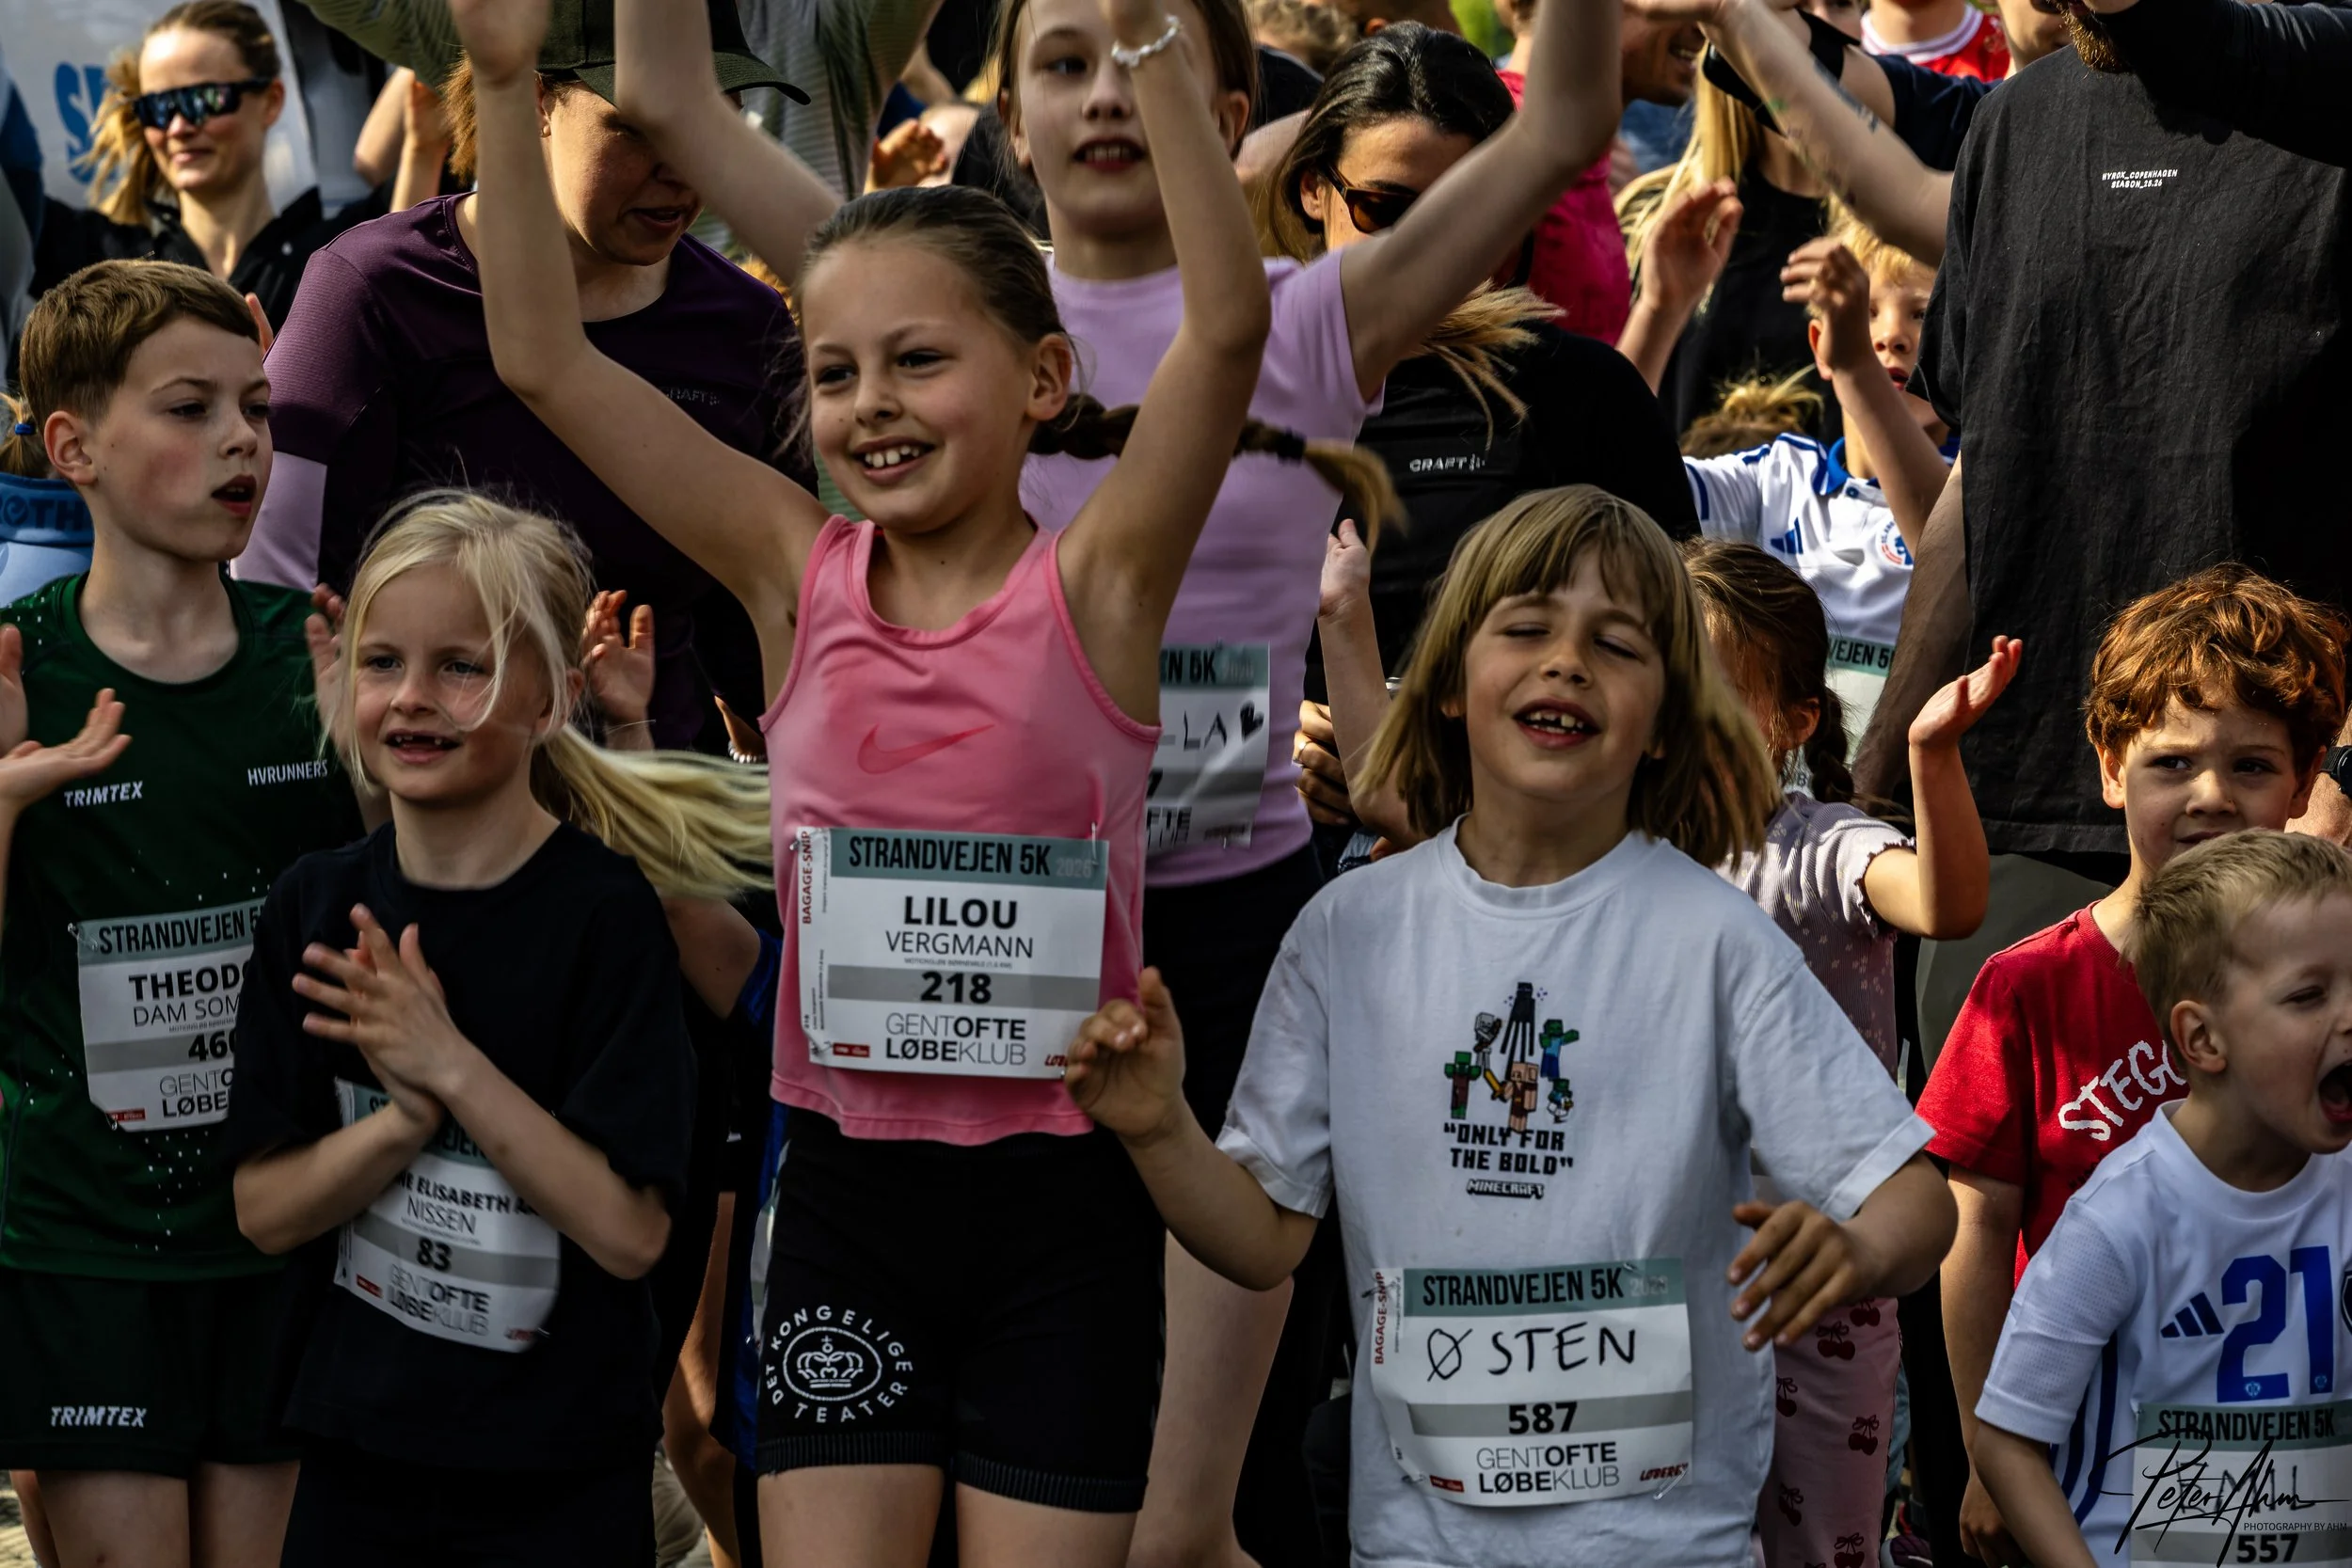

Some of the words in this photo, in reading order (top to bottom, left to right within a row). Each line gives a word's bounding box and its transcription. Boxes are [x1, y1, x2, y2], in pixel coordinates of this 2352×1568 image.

[1409, 456, 1467, 472] CRAFT
[247, 759, 328, 786] HVRUNNERS
[64, 781, 144, 808] TRIMTEX
[849, 835, 1013, 874] STRANDVEJEN
[1019, 844, 1051, 877] 5K
[903, 895, 1018, 929] LILOU
[99, 909, 245, 955] STRANDVEJEN
[885, 930, 1033, 958] VERGMANN
[920, 970, 992, 1005] 218
[134, 1004, 186, 1027] DAM
[885, 1012, 1026, 1041] GENTOFTE
[885, 1037, 1026, 1066] LØBEKLUB
[162, 1088, 231, 1118] LØBE
[1519, 1129, 1565, 1151] FOR
[1450, 1148, 1491, 1170] THE
[417, 1175, 511, 1215] ELISABETH
[1466, 1179, 1546, 1200] MINECRAFT
[406, 1195, 476, 1235] NISSEN
[417, 1236, 452, 1272] 83
[1422, 1271, 1583, 1307] STRANDVEJEN
[1591, 1267, 1624, 1300] 5K
[771, 1305, 914, 1371] KONGELIGE
[2216, 1244, 2334, 1403] 21
[766, 1364, 785, 1405] DET
[51, 1405, 147, 1428] TRIMTEX
[794, 1381, 909, 1423] TEATER
[1508, 1401, 1578, 1435] 587
[2157, 1409, 2310, 1442] STRANDVEJEN
[2314, 1407, 2336, 1438] 5K
[1476, 1441, 1618, 1470] GENTOFTE
[1478, 1465, 1620, 1494] LØBEKLUB
[2236, 1533, 2298, 1564] 557
